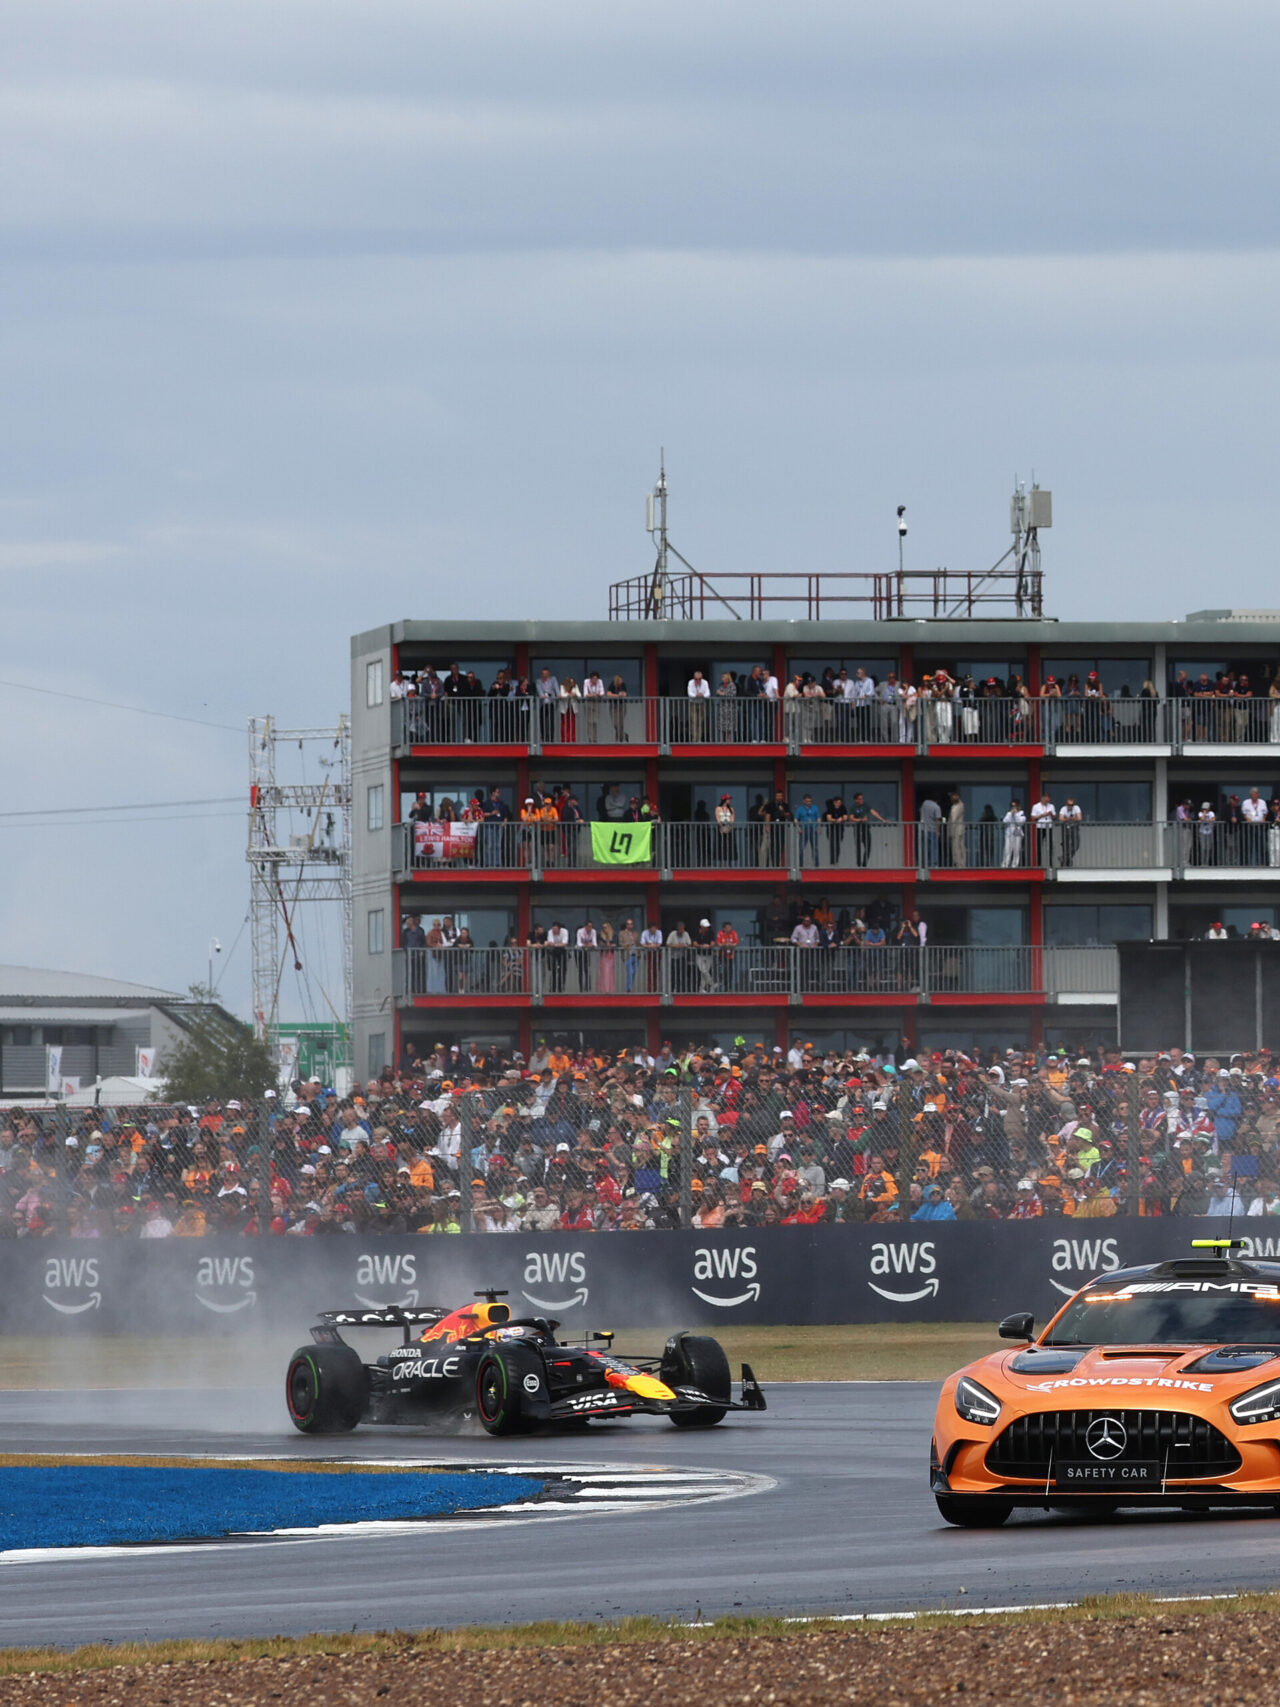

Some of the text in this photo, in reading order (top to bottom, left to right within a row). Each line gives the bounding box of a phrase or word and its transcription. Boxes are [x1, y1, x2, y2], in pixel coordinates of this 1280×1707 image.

[524, 1251, 586, 1284] aws
[693, 1246, 757, 1279] aws
[870, 1241, 936, 1275] aws
[1051, 1238, 1120, 1271] aws
[45, 1257, 99, 1287] aws
[196, 1256, 255, 1287] aws
[356, 1254, 417, 1286] aws
[1170, 1282, 1279, 1294] AMG
[389, 1348, 422, 1358] HONDA
[391, 1356, 463, 1381] ORACLE
[1034, 1377, 1214, 1392] CROWDSTRIKE
[566, 1392, 618, 1410] VISA
[1067, 1467, 1148, 1478] SAFETY CAR
